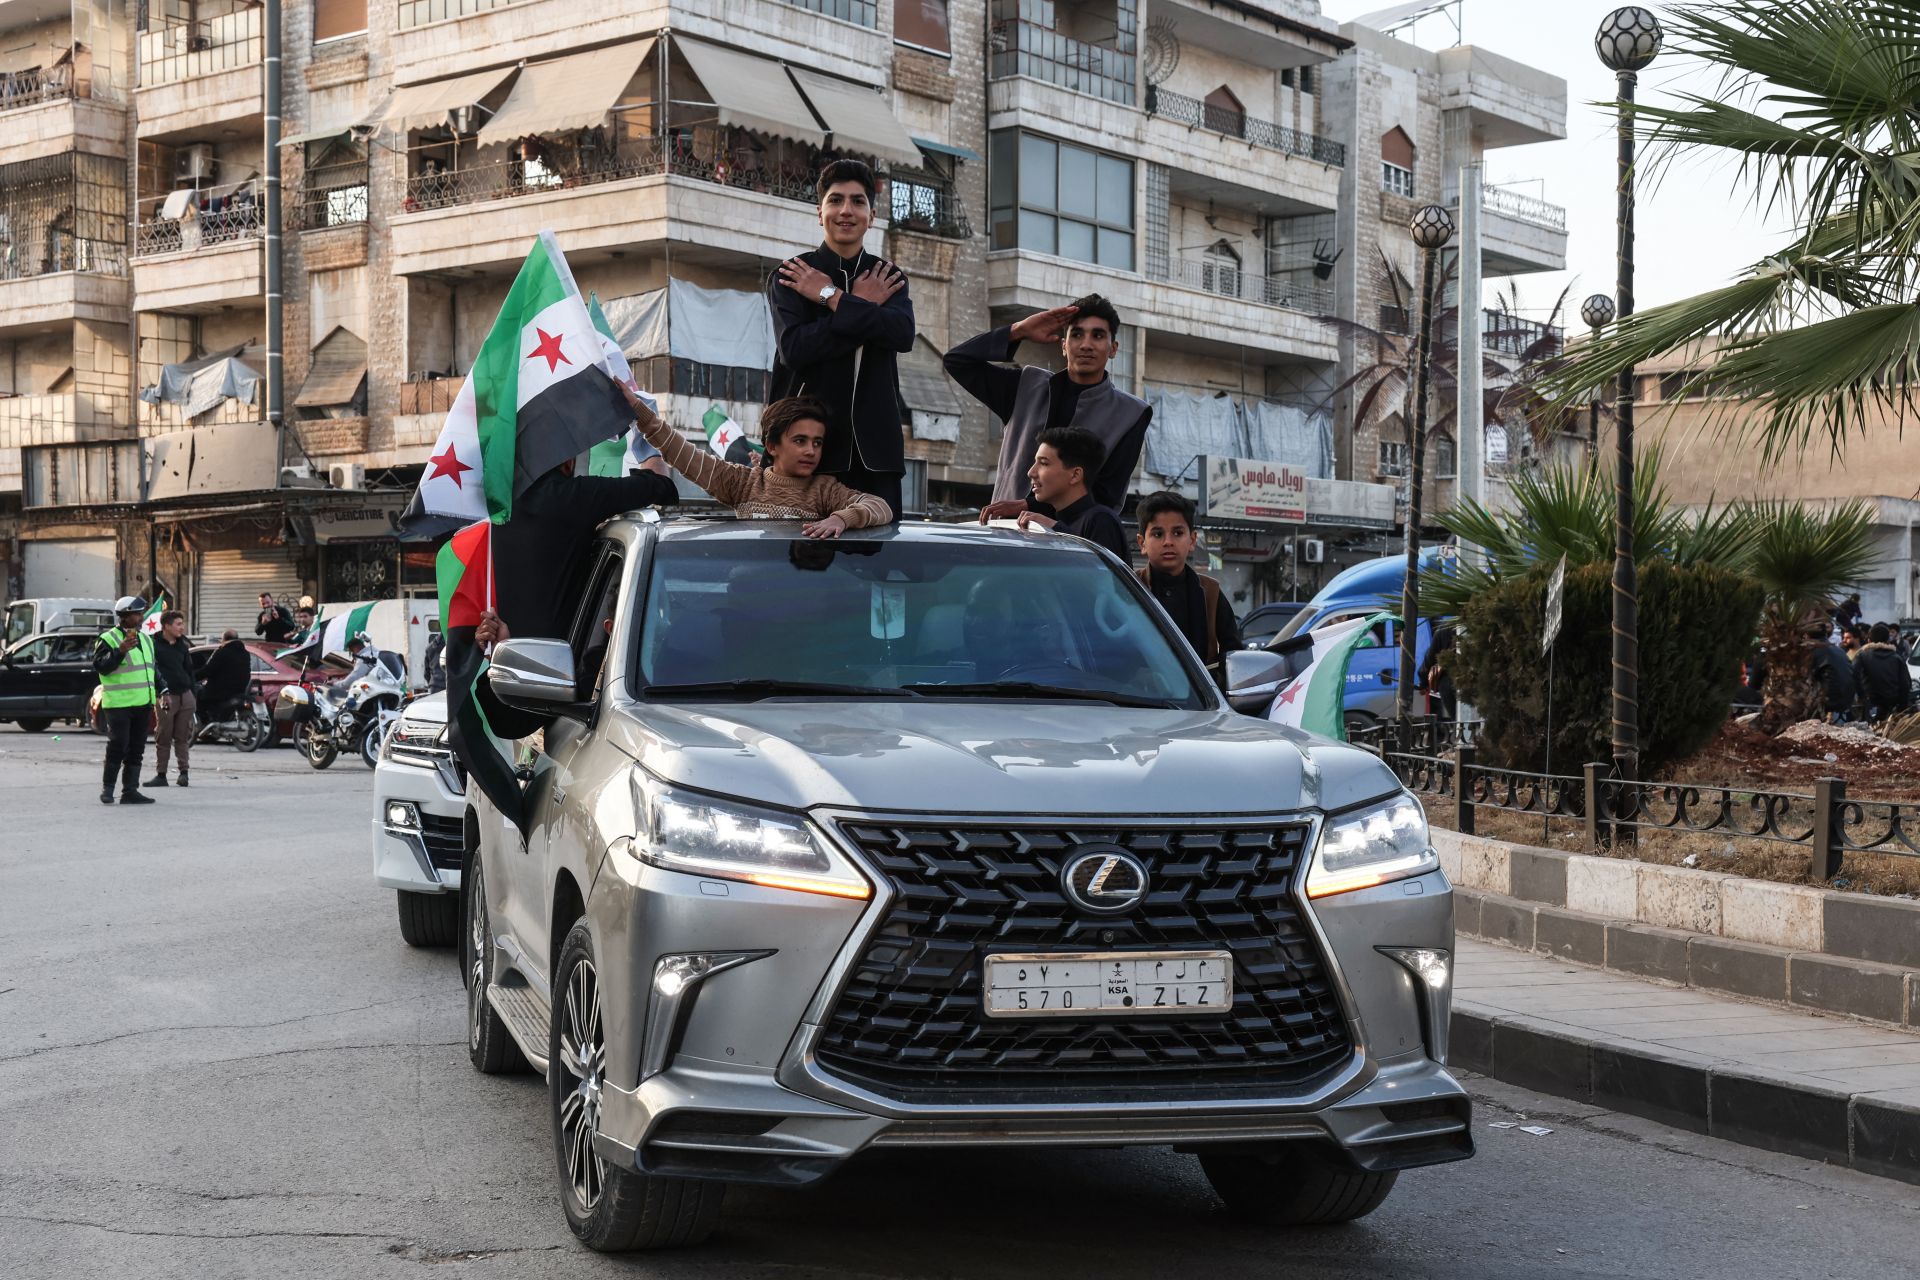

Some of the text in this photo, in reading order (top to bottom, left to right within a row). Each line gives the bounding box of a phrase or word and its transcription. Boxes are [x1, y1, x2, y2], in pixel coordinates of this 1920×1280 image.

[1242, 466, 1303, 492] رويال هاوس
[1018, 990, 1072, 1009] 570
[1108, 986, 1129, 994] KSA
[1153, 985, 1209, 1006] ZLZ
